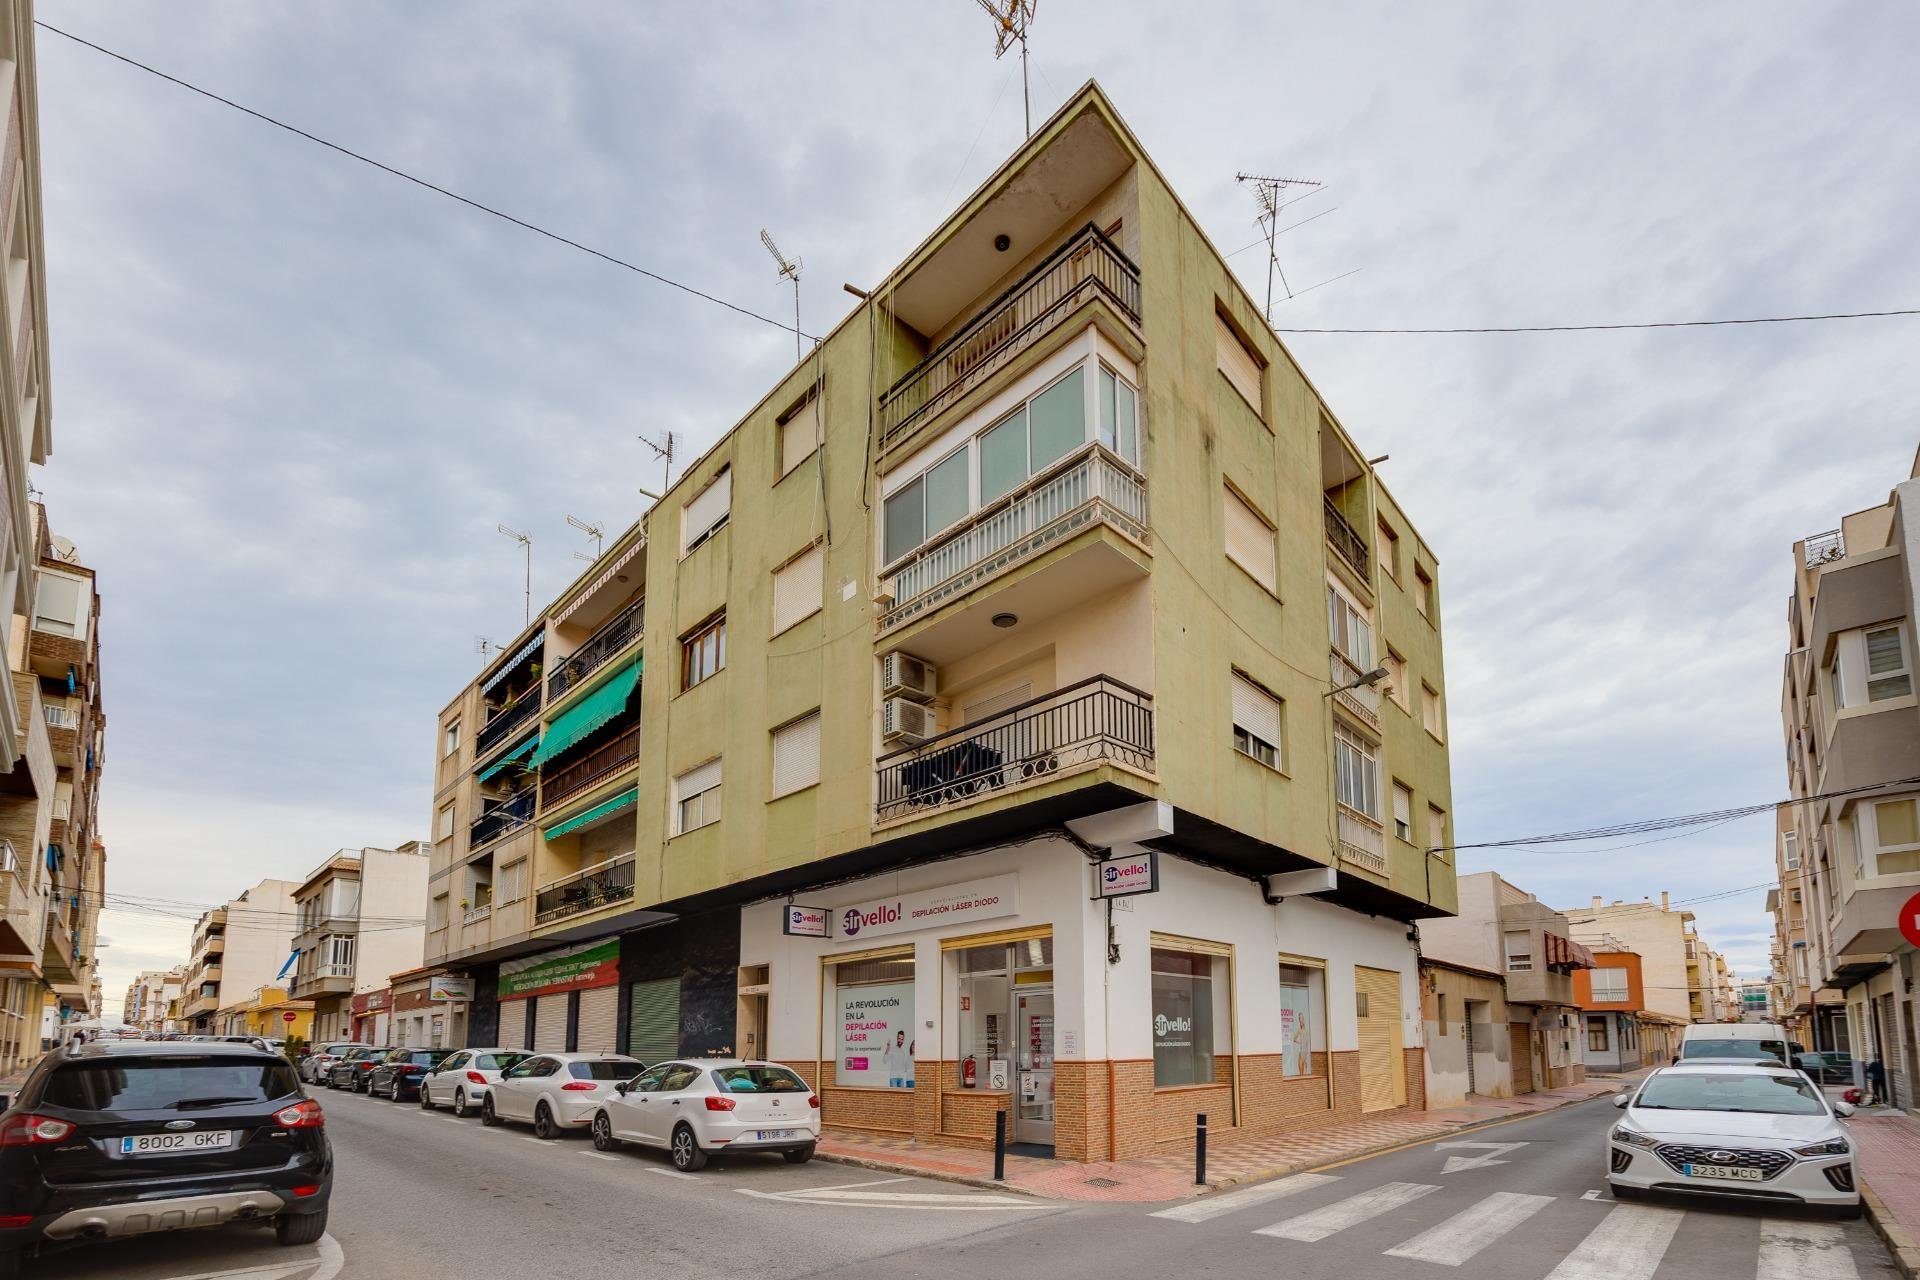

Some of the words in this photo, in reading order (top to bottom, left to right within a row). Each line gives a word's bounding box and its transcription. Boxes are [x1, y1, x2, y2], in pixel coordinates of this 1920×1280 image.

[912, 904, 950, 919] DEPILACIÓN
[952, 900, 973, 912] LÁSER
[974, 896, 999, 908] DIODO
[856, 997, 899, 1009] REVOLUCIÓN
[846, 1020, 887, 1031] DEPILACIÓN
[846, 1032, 867, 1041] LÁSER
[138, 1135, 185, 1150] 8002
[194, 1132, 226, 1146] GKF
[762, 1131, 780, 1139] 5196
[1692, 1166, 1726, 1177] 5235
[1731, 1168, 1758, 1179] MCC
